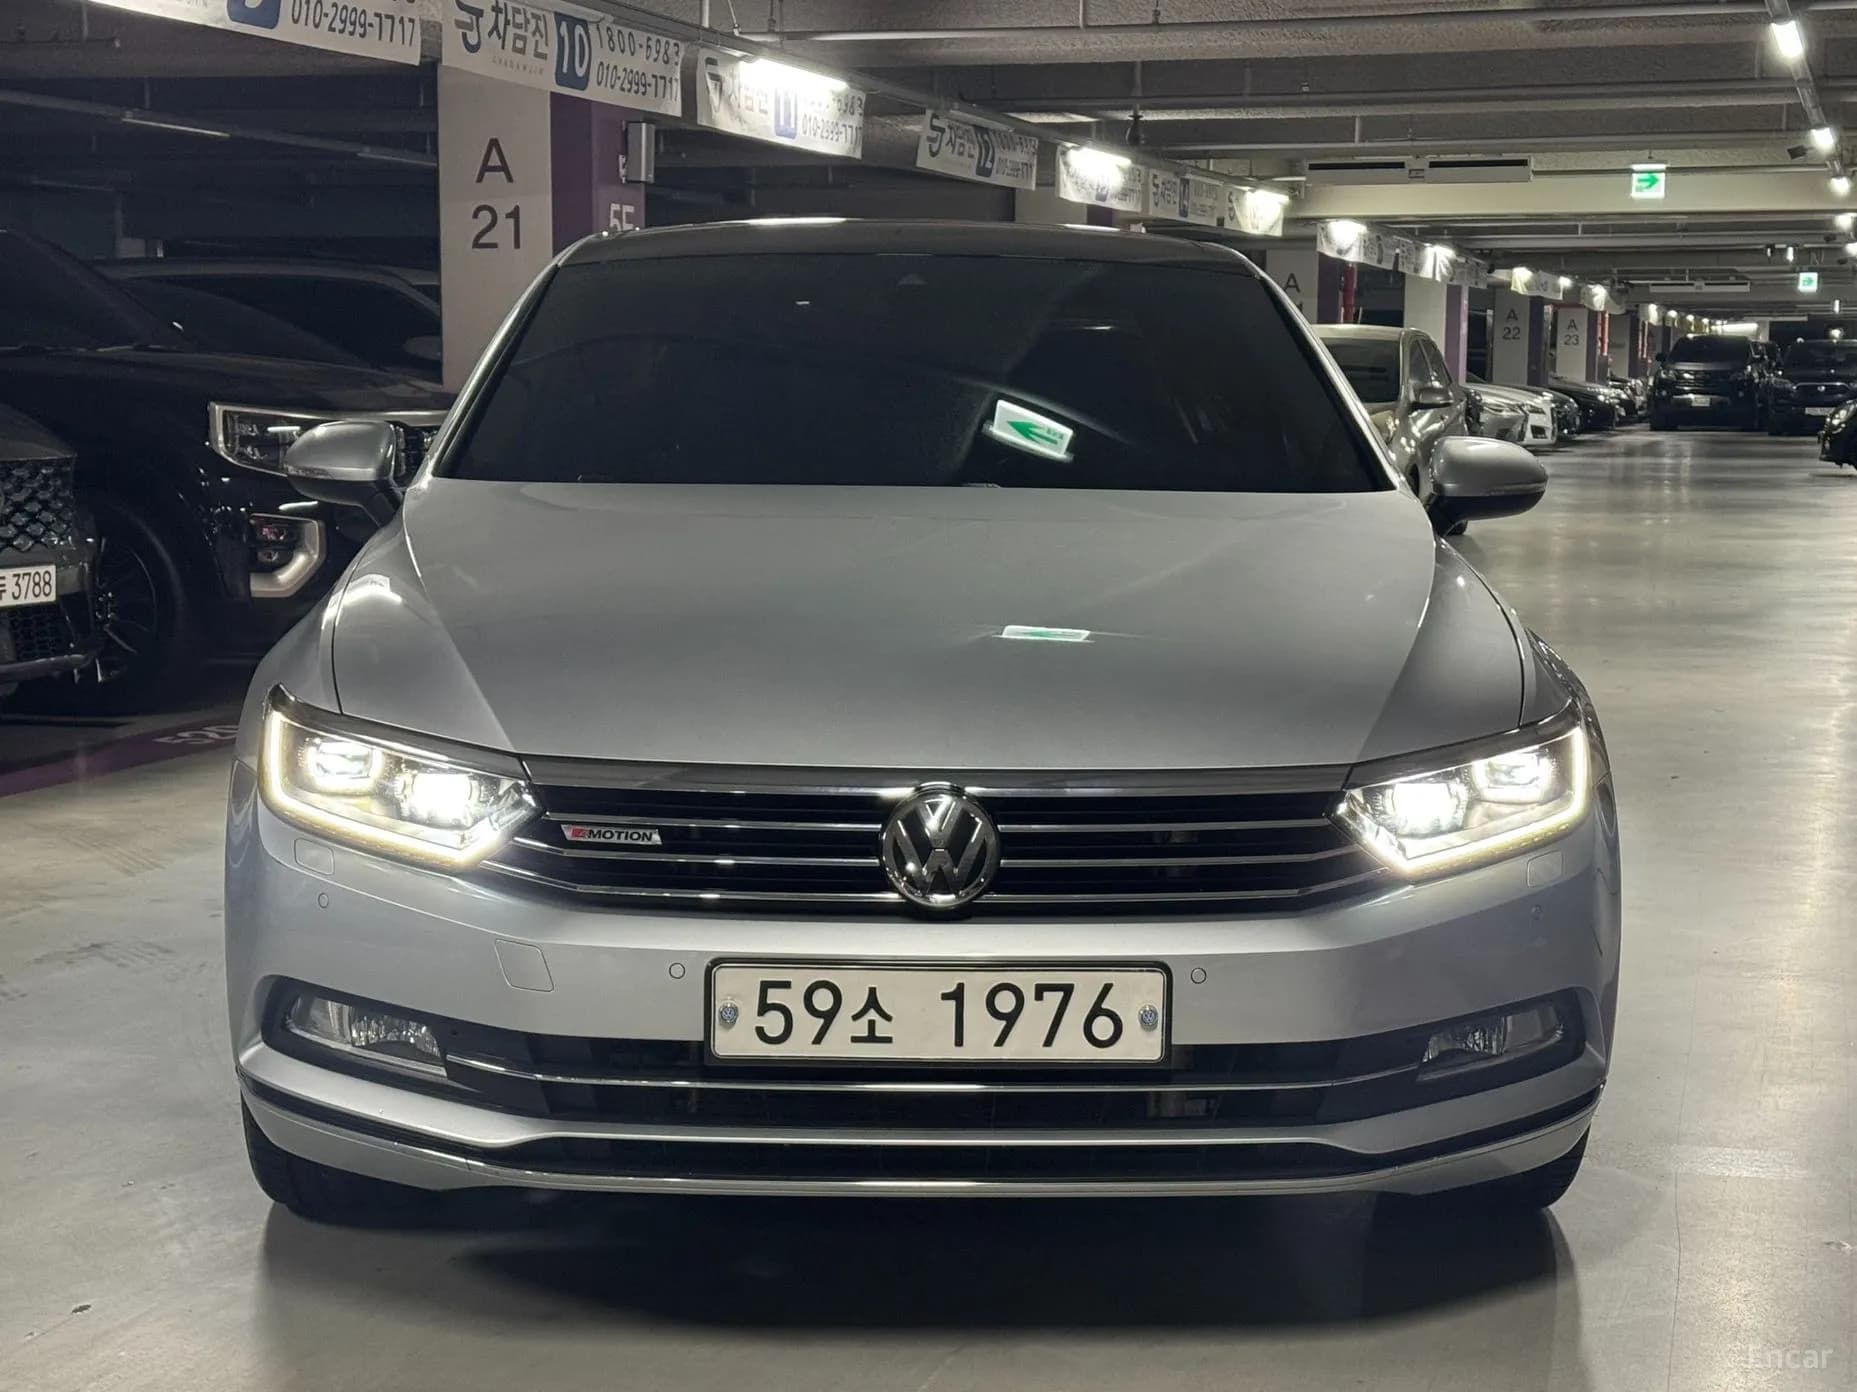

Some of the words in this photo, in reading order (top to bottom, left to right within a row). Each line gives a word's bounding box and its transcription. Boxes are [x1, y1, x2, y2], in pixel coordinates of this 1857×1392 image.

[290, 0, 416, 47] 010-2999-7717
[487, 0, 549, 61] 차담진
[559, 20, 590, 78] 10
[596, 60, 681, 103] 010-2999-7717
[475, 137, 514, 183] A
[471, 204, 521, 249] 21
[1283, 271, 1301, 293] A
[1502, 326, 1521, 341] 22
[1506, 308, 1518, 321] A
[1567, 319, 1578, 331] A
[1564, 334, 1580, 346] 23
[12, 570, 52, 600] 3788
[754, 979, 894, 1046] 59소
[940, 981, 1124, 1049] 1976
